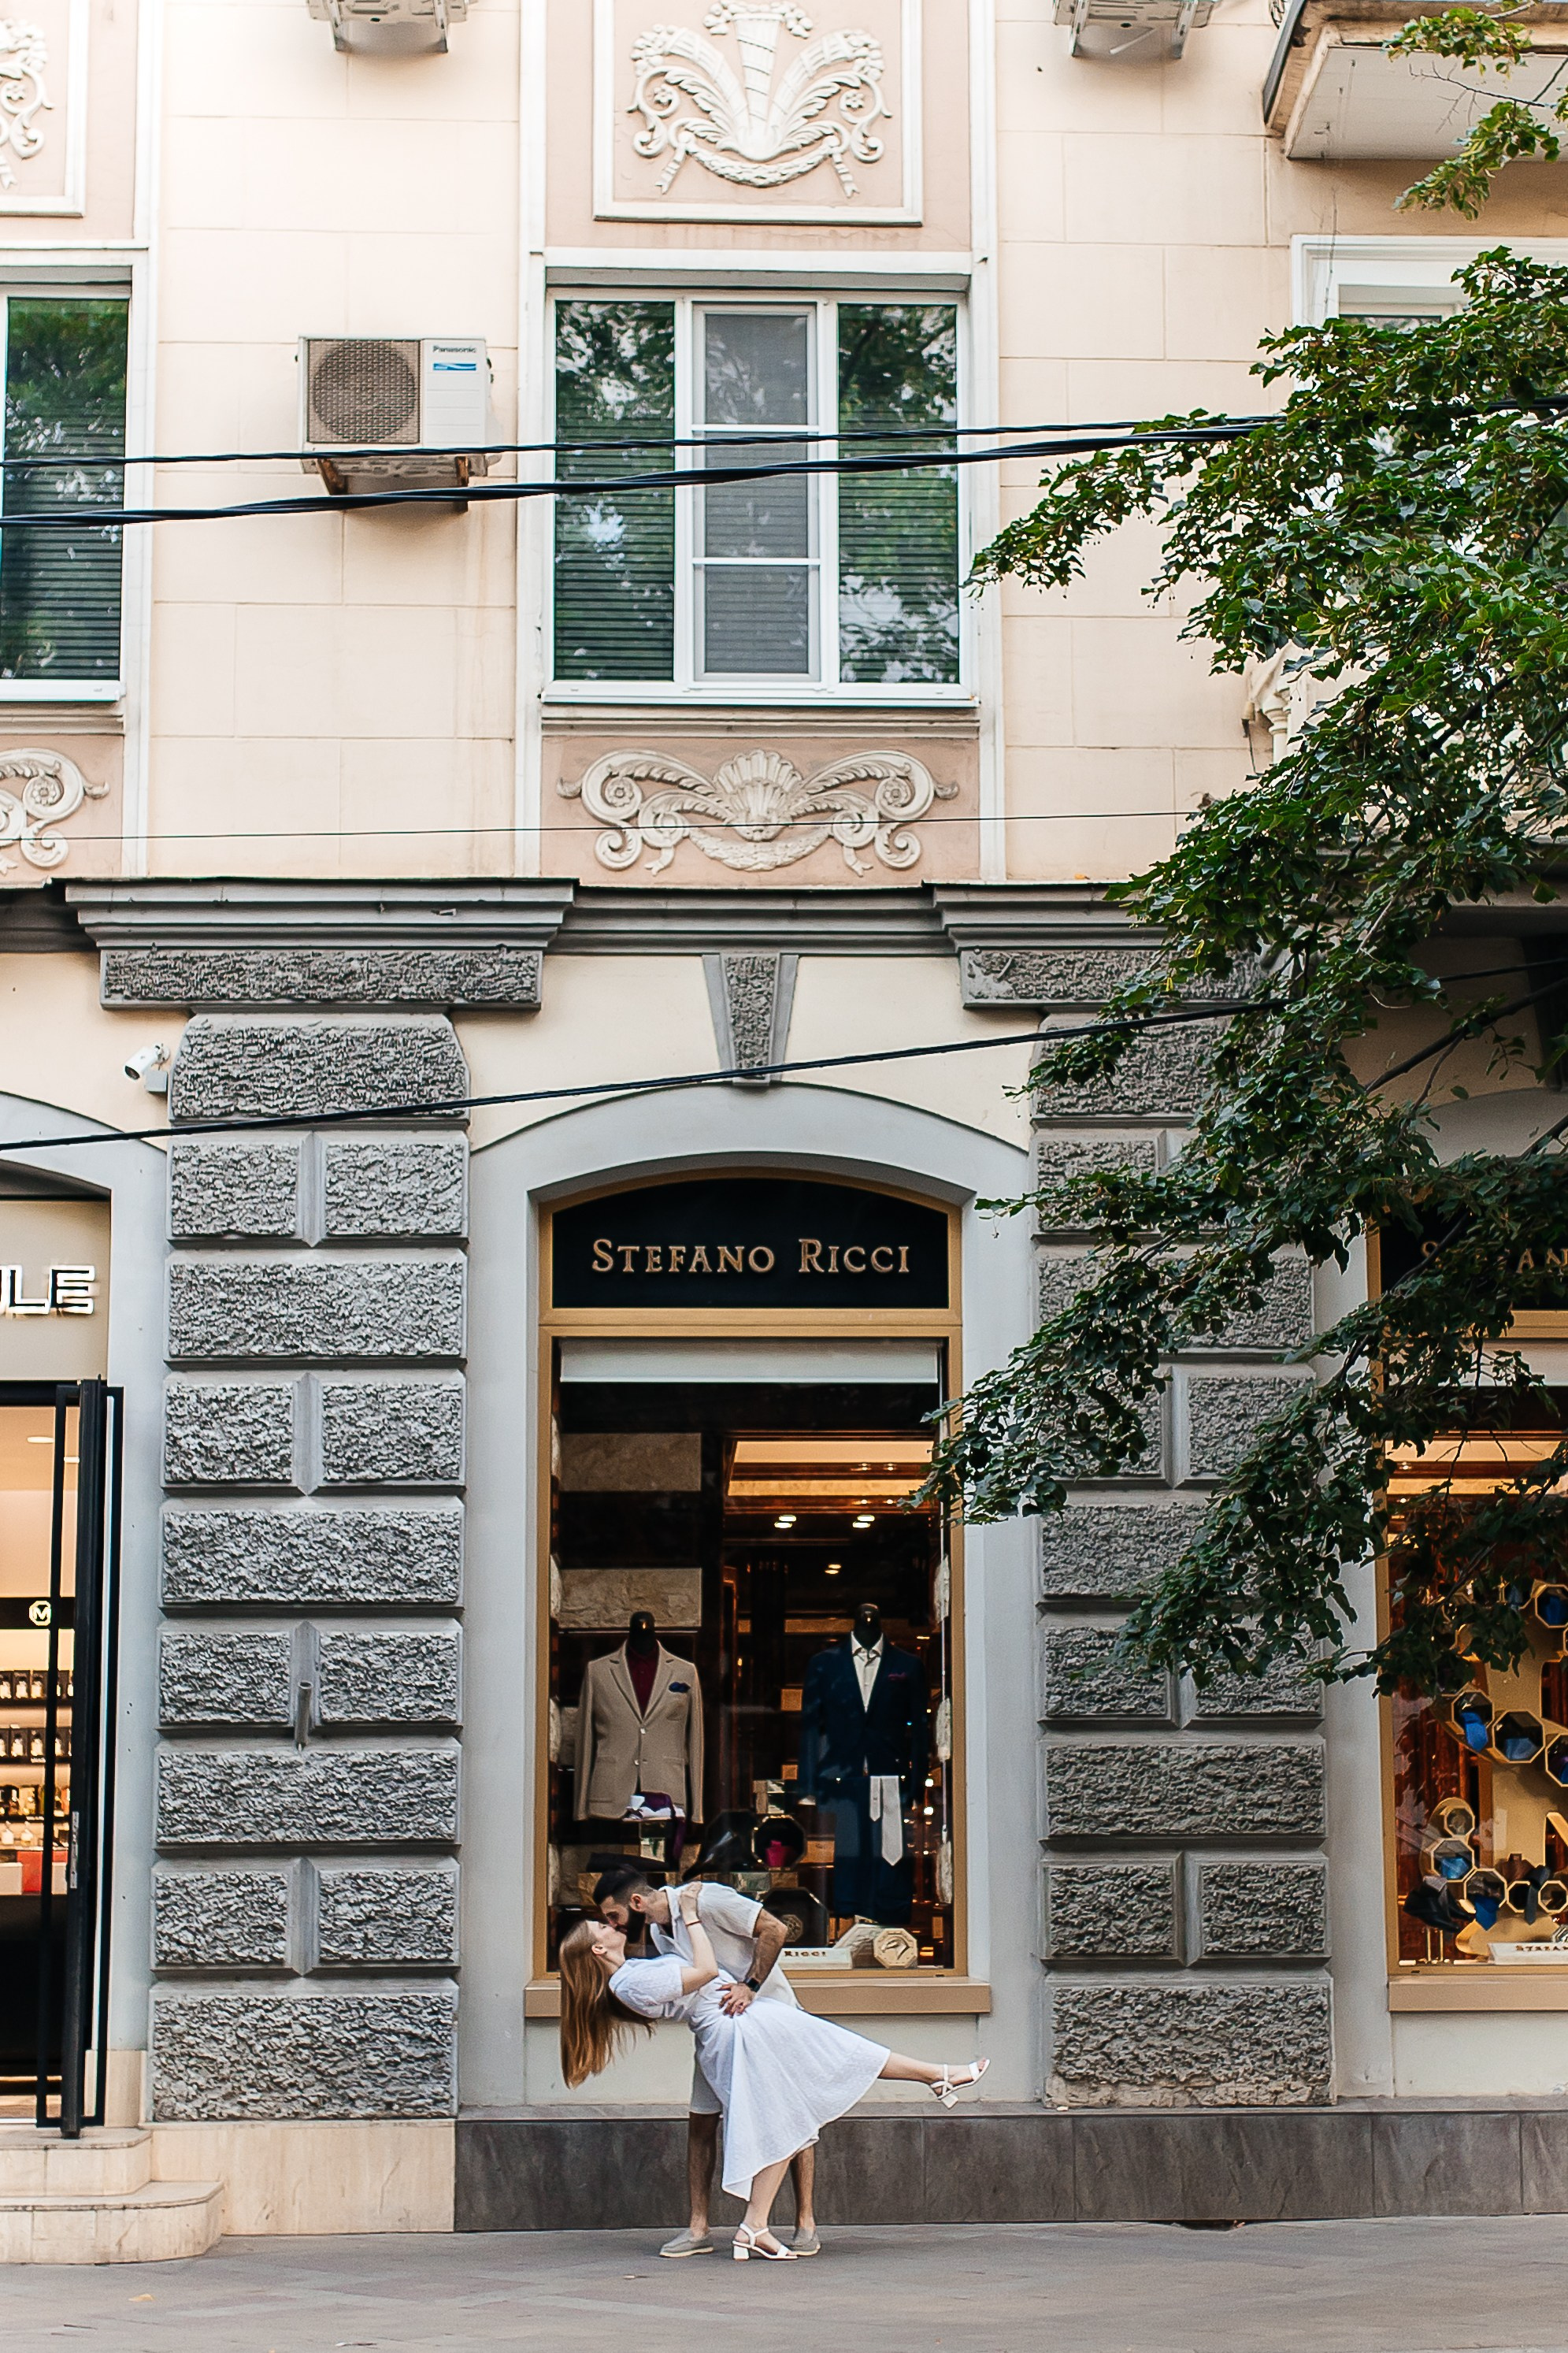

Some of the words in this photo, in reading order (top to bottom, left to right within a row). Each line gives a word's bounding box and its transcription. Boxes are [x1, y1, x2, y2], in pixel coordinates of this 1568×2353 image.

[592, 1238, 775, 1273] STEFANO
[799, 1238, 910, 1273] RICCI
[0, 1265, 95, 1314] LE
